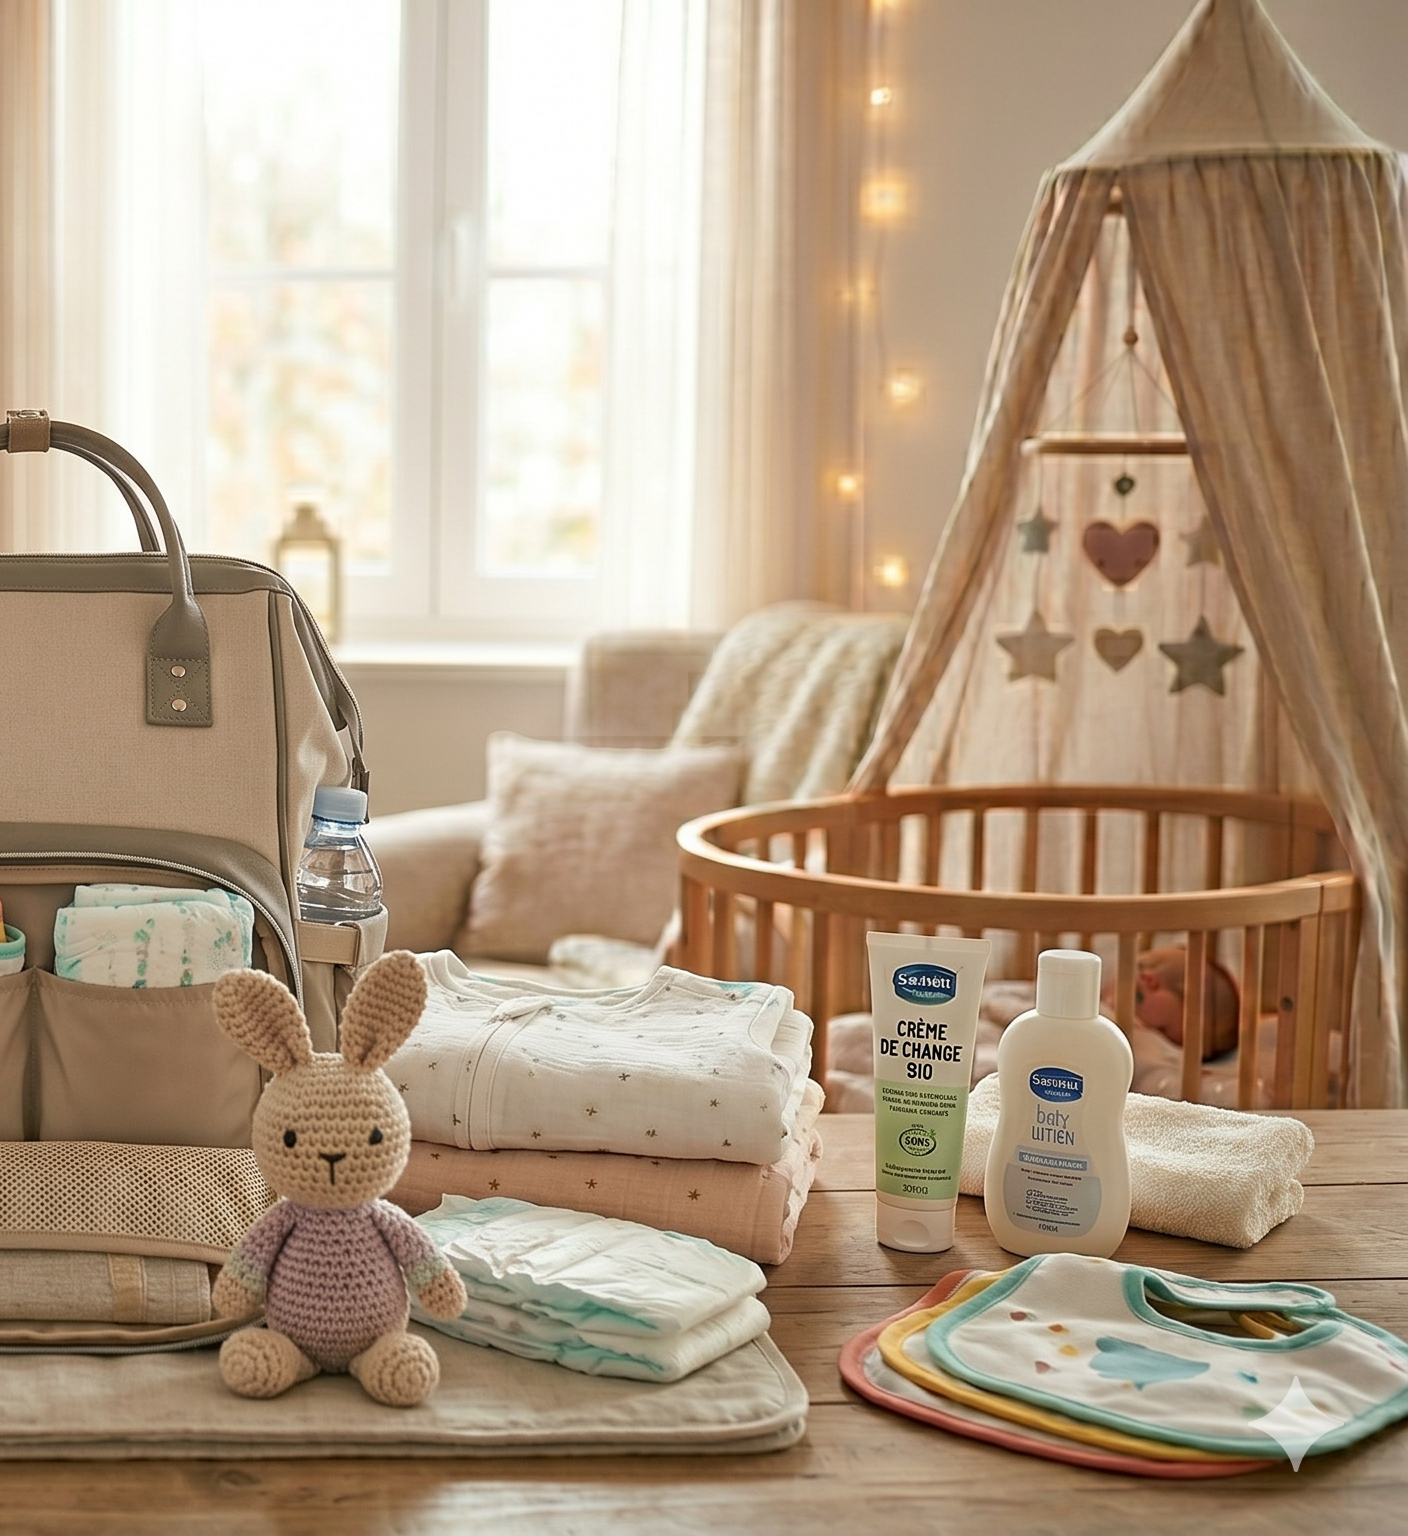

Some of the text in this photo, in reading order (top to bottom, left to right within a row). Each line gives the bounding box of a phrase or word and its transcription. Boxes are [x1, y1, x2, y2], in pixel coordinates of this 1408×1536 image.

[897, 1017, 948, 1041] CRÈME
[880, 1038, 963, 1063] DE CHANGE
[904, 1136, 930, 1147] SONS
